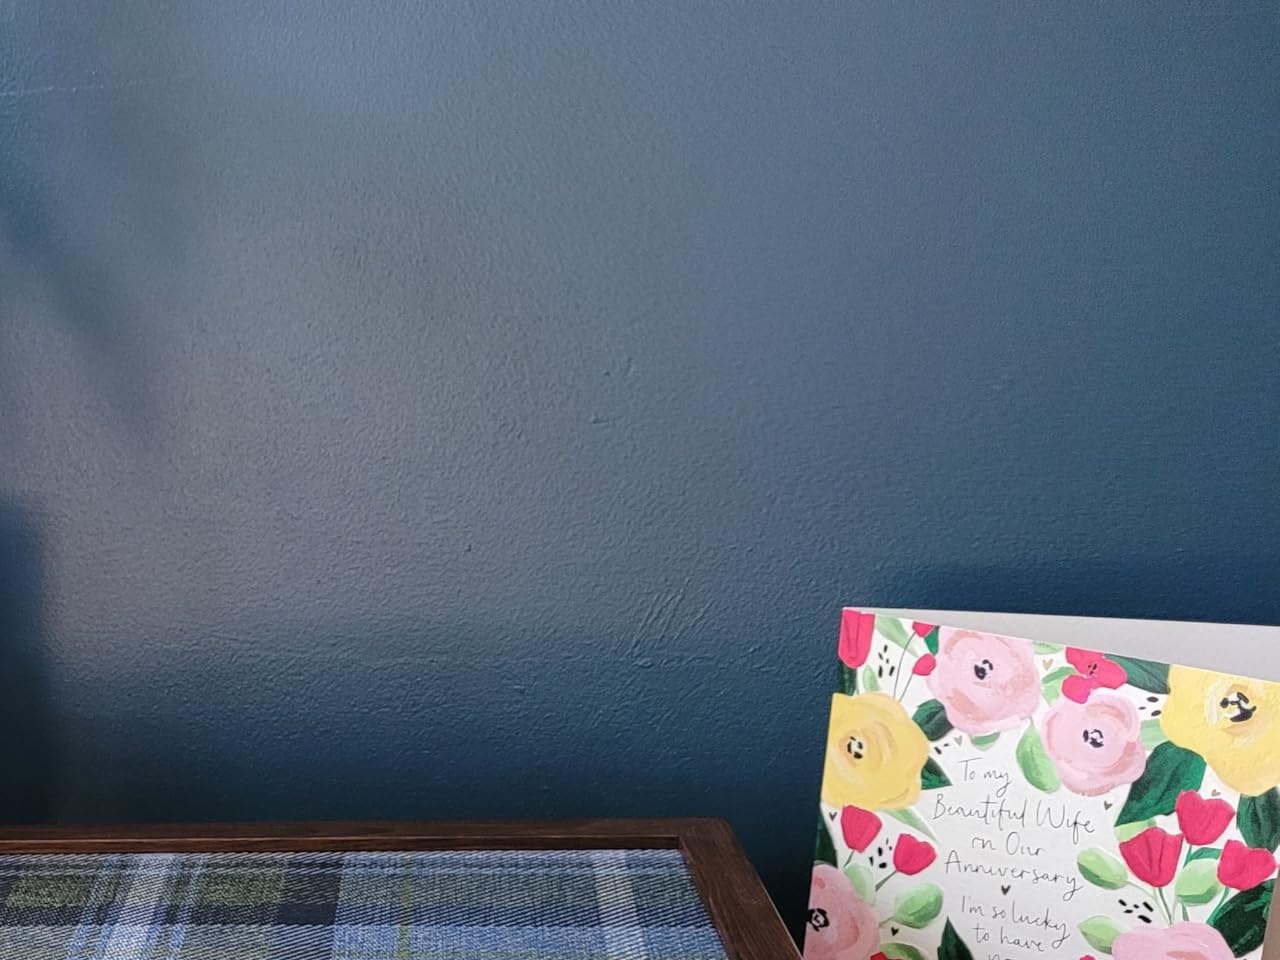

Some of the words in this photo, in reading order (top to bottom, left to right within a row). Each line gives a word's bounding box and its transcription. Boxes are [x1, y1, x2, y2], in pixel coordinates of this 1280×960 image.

[958, 757, 983, 782] To
[984, 771, 1012, 798] my
[933, 793, 1028, 831] Beautiful
[1036, 800, 1095, 844] Wife
[972, 836, 996, 851] on
[1006, 832, 1044, 856] Our
[944, 850, 1084, 901] Anniversary
[973, 923, 991, 944] to
[1000, 927, 1045, 952] have
[992, 903, 1008, 919] so
[1012, 901, 1071, 948] lucky
